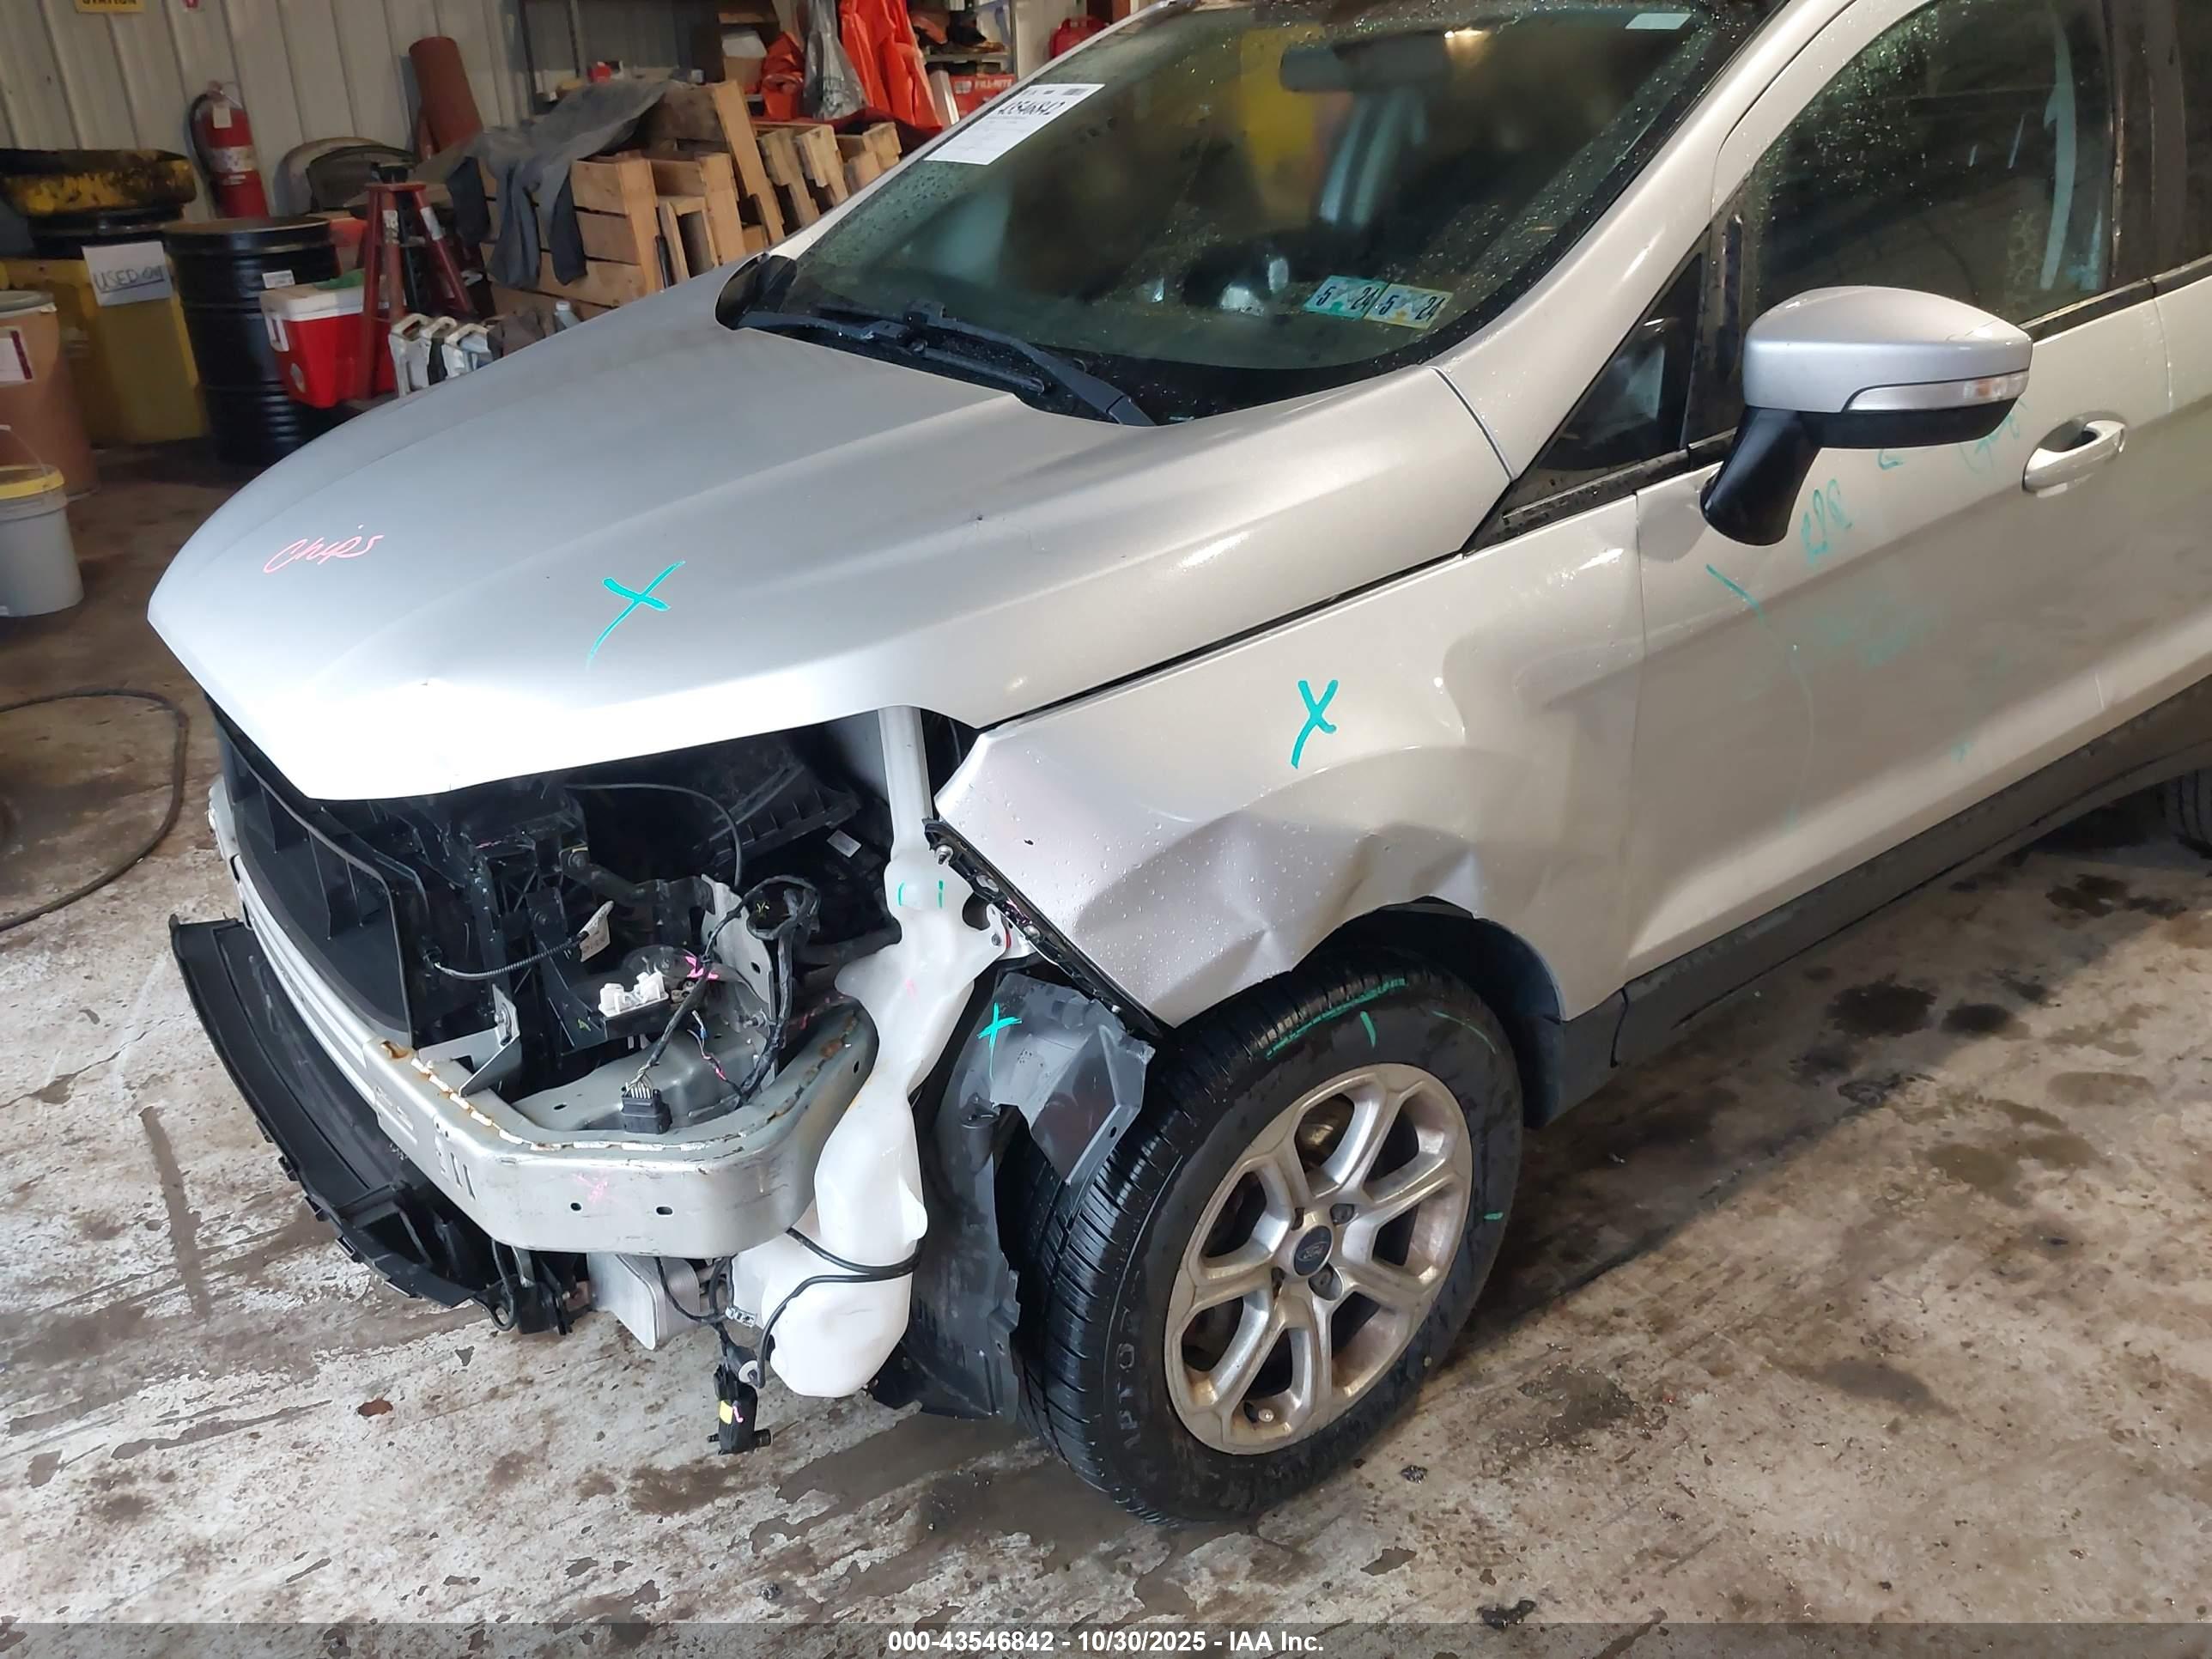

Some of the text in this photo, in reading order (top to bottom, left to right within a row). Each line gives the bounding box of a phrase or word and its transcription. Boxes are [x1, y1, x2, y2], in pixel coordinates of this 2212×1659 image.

[93, 268, 138, 291] USED
[1349, 286, 1381, 312] 24
[1414, 295, 1446, 322] 24
